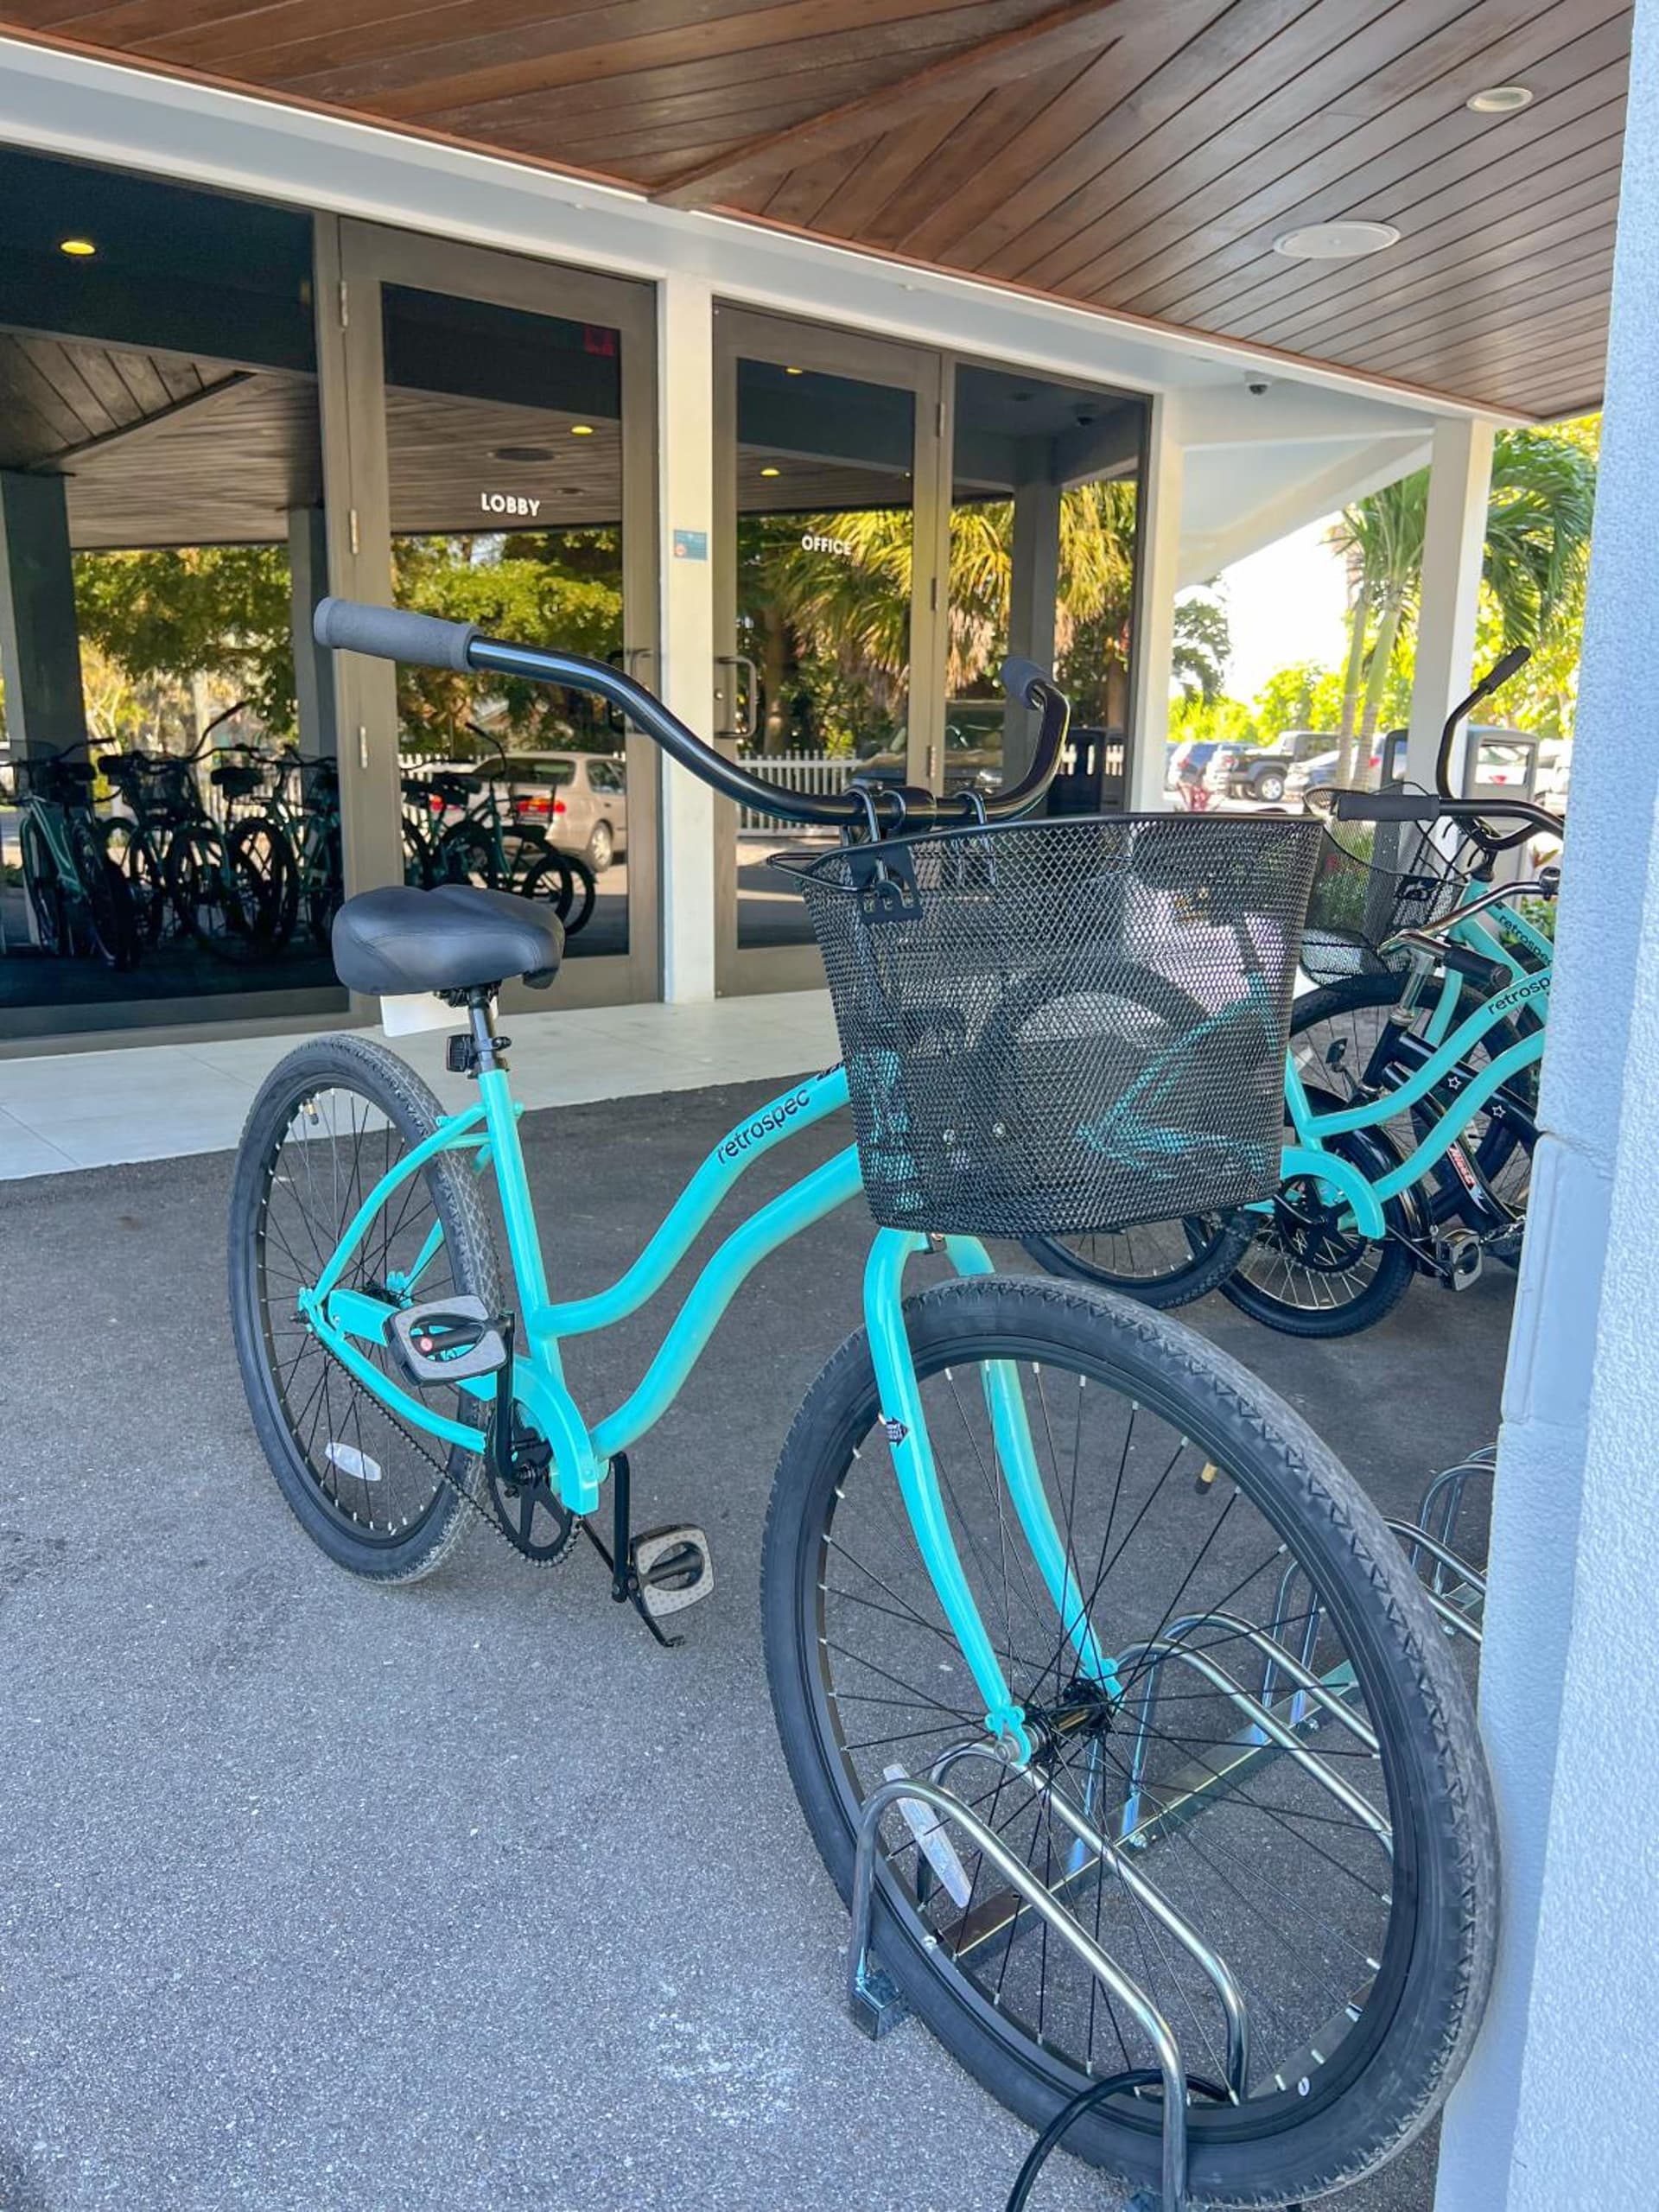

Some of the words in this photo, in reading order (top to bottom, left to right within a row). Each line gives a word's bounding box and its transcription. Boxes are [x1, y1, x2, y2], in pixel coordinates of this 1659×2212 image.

[480, 493, 540, 517] LOBBY
[801, 535, 852, 556] OFFICE
[1487, 976, 1552, 1014] retrosp
[717, 1089, 810, 1164] retrospec
